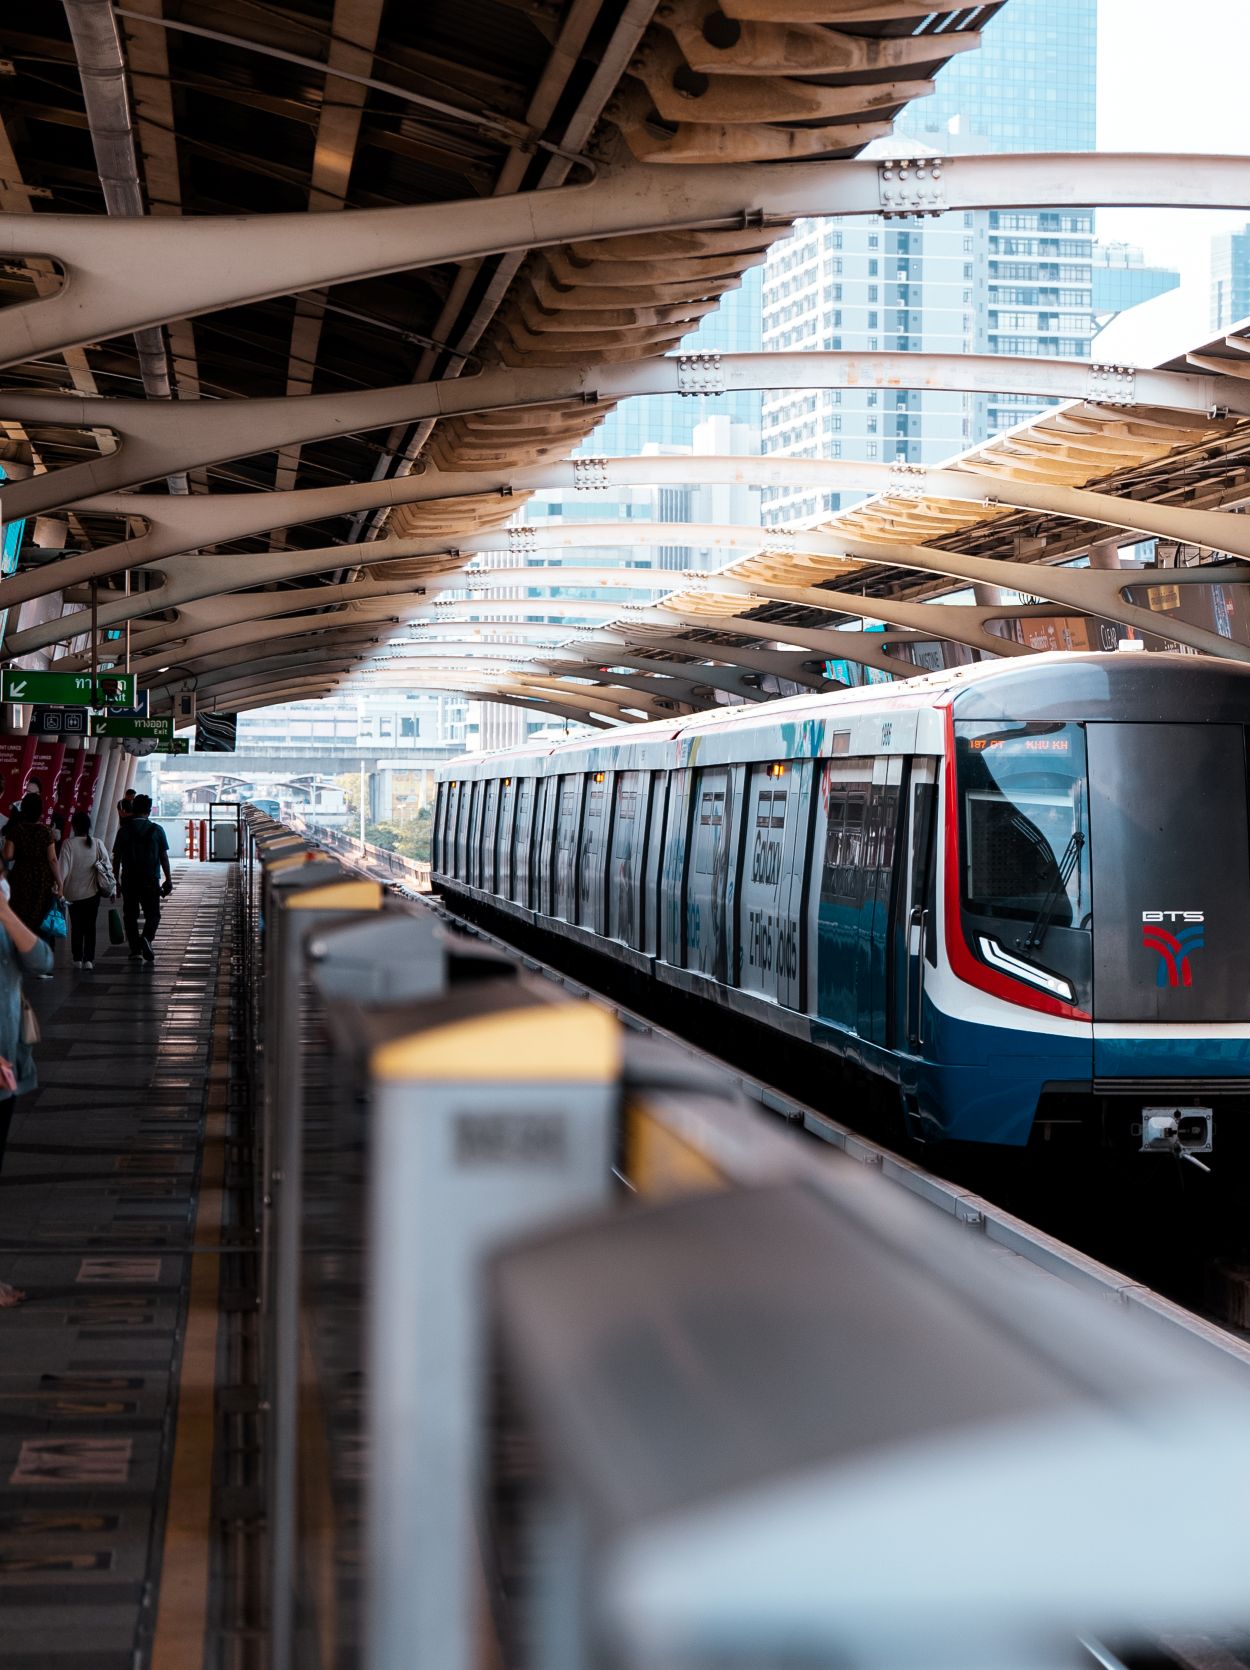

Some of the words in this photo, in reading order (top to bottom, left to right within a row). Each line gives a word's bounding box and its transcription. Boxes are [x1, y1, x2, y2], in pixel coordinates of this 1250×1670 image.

[134, 719, 169, 728] ทางออก
[1142, 911, 1205, 922] BTS
